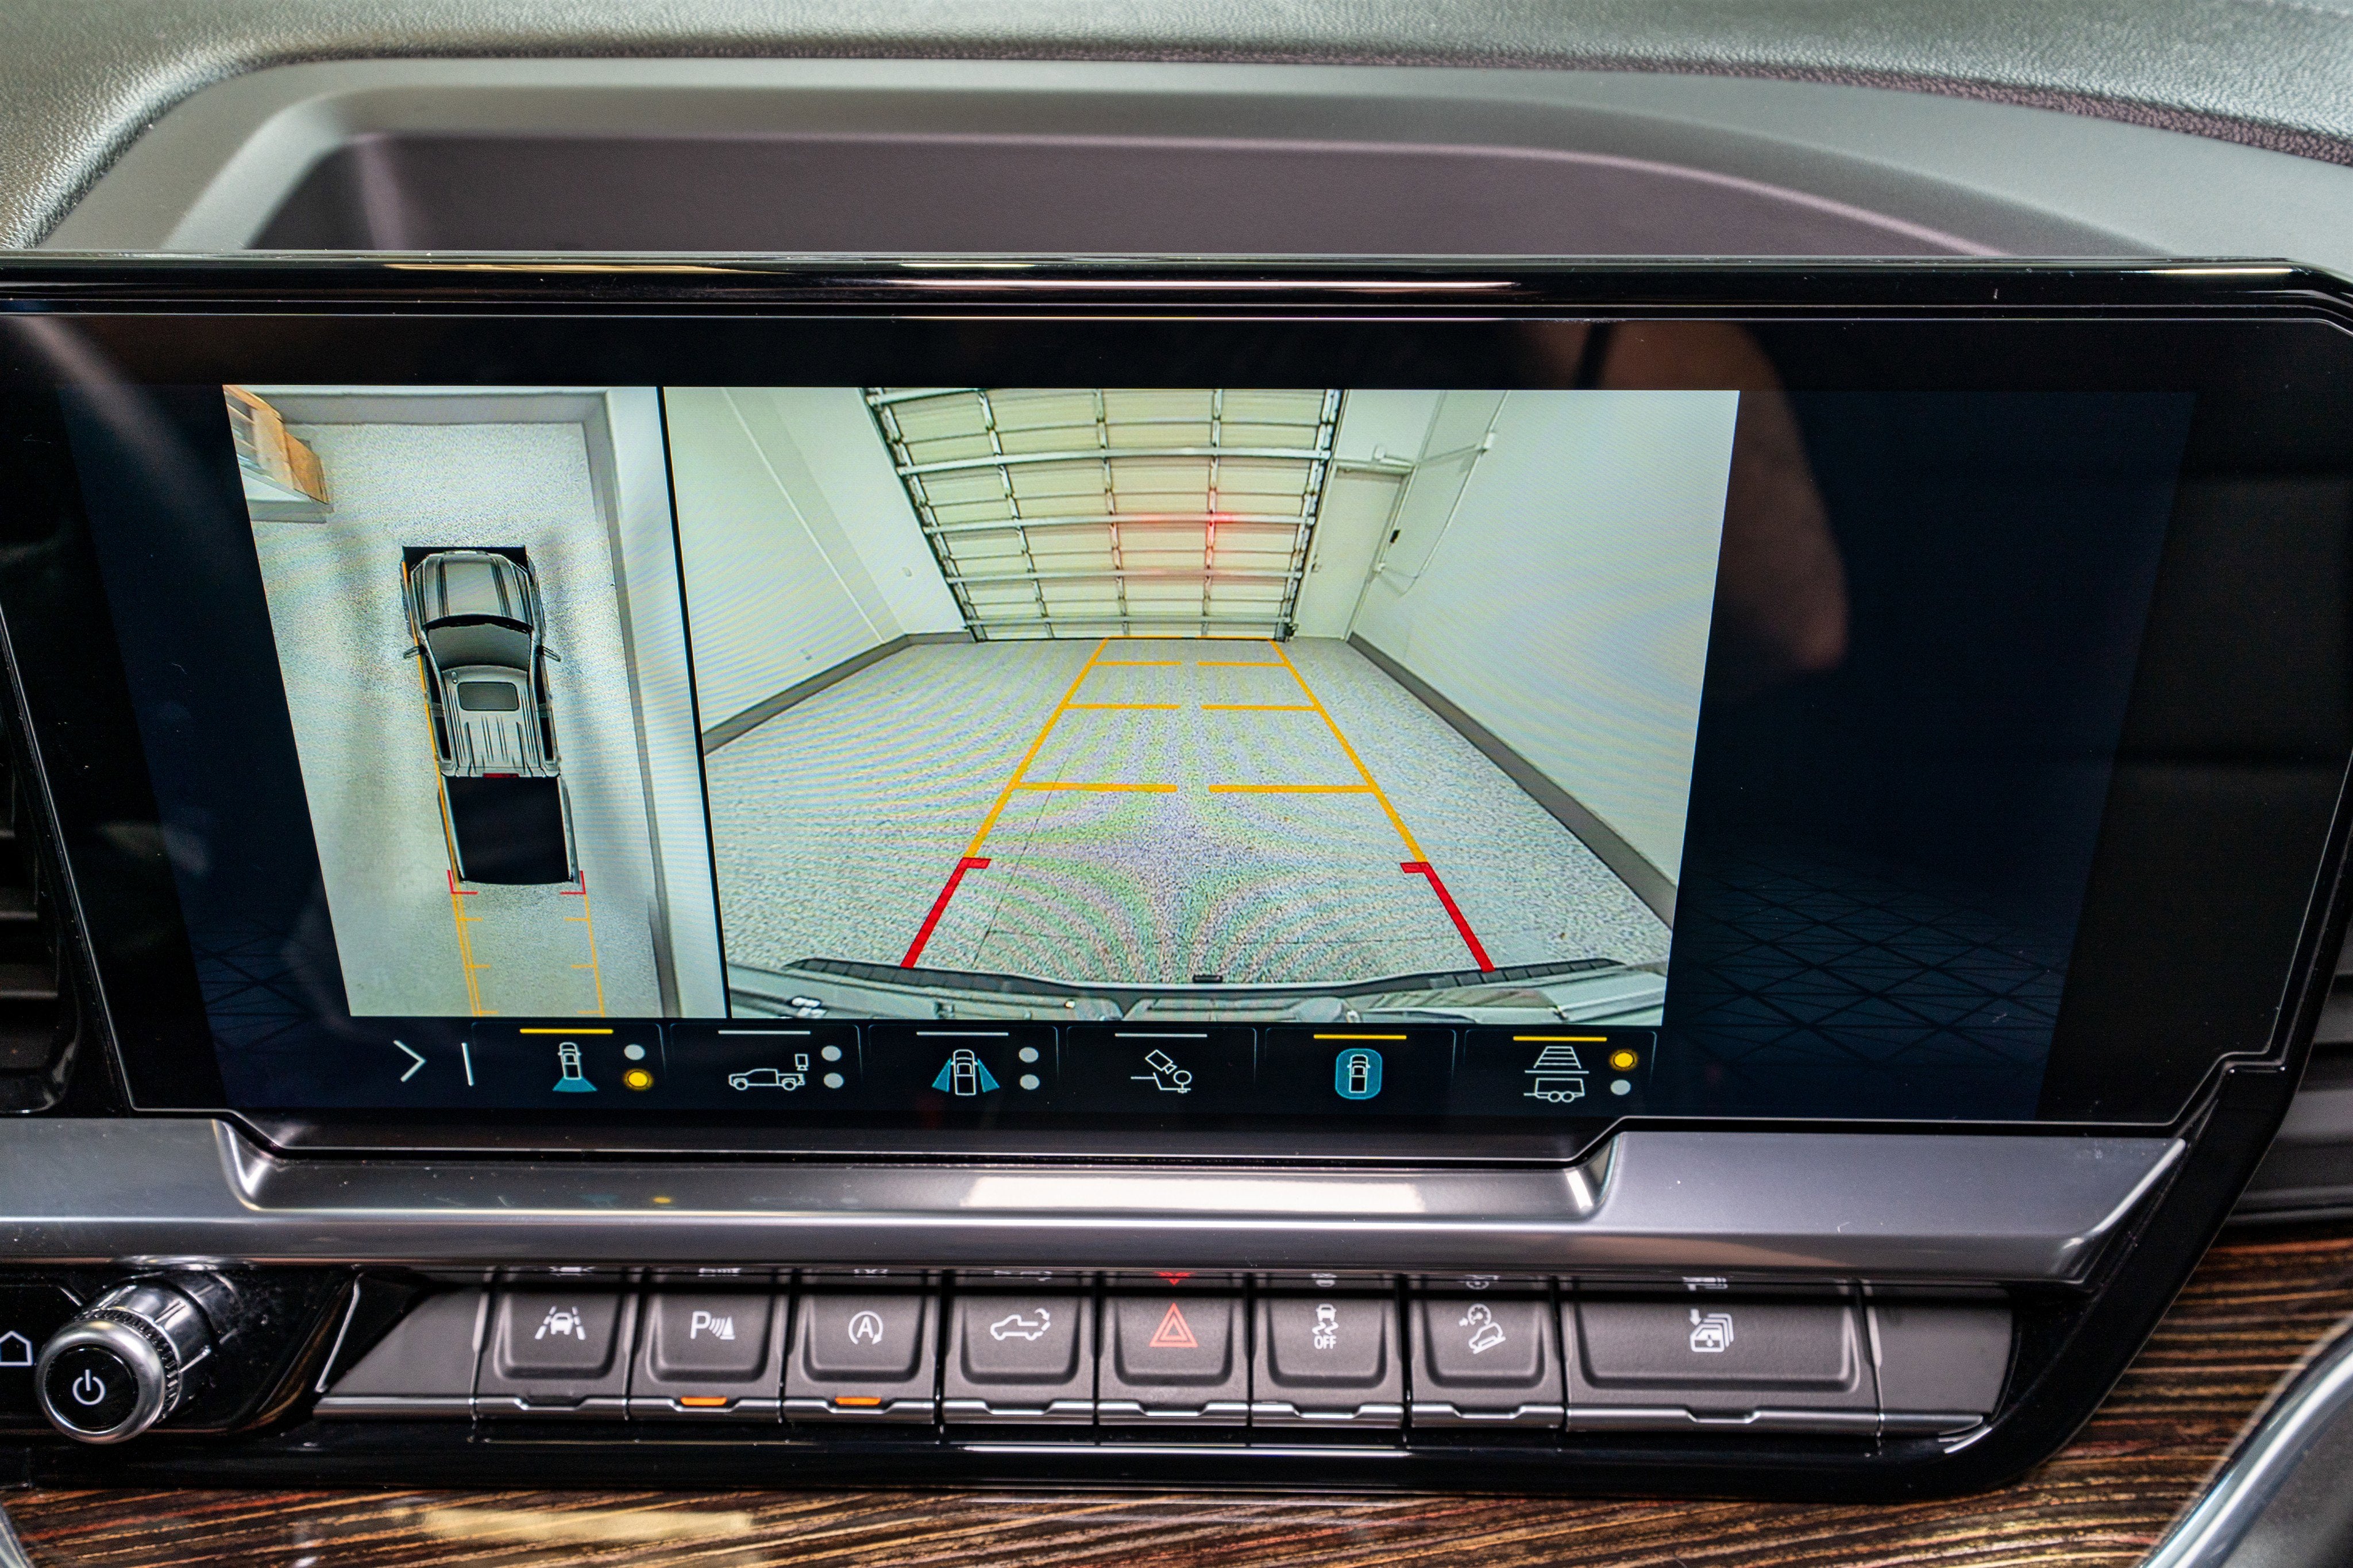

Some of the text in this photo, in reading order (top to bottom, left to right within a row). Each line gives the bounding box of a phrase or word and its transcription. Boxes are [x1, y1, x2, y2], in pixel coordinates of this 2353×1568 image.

[690, 1311, 711, 1339] P
[857, 1315, 873, 1338] A
[1314, 1335, 1337, 1350] OFF
